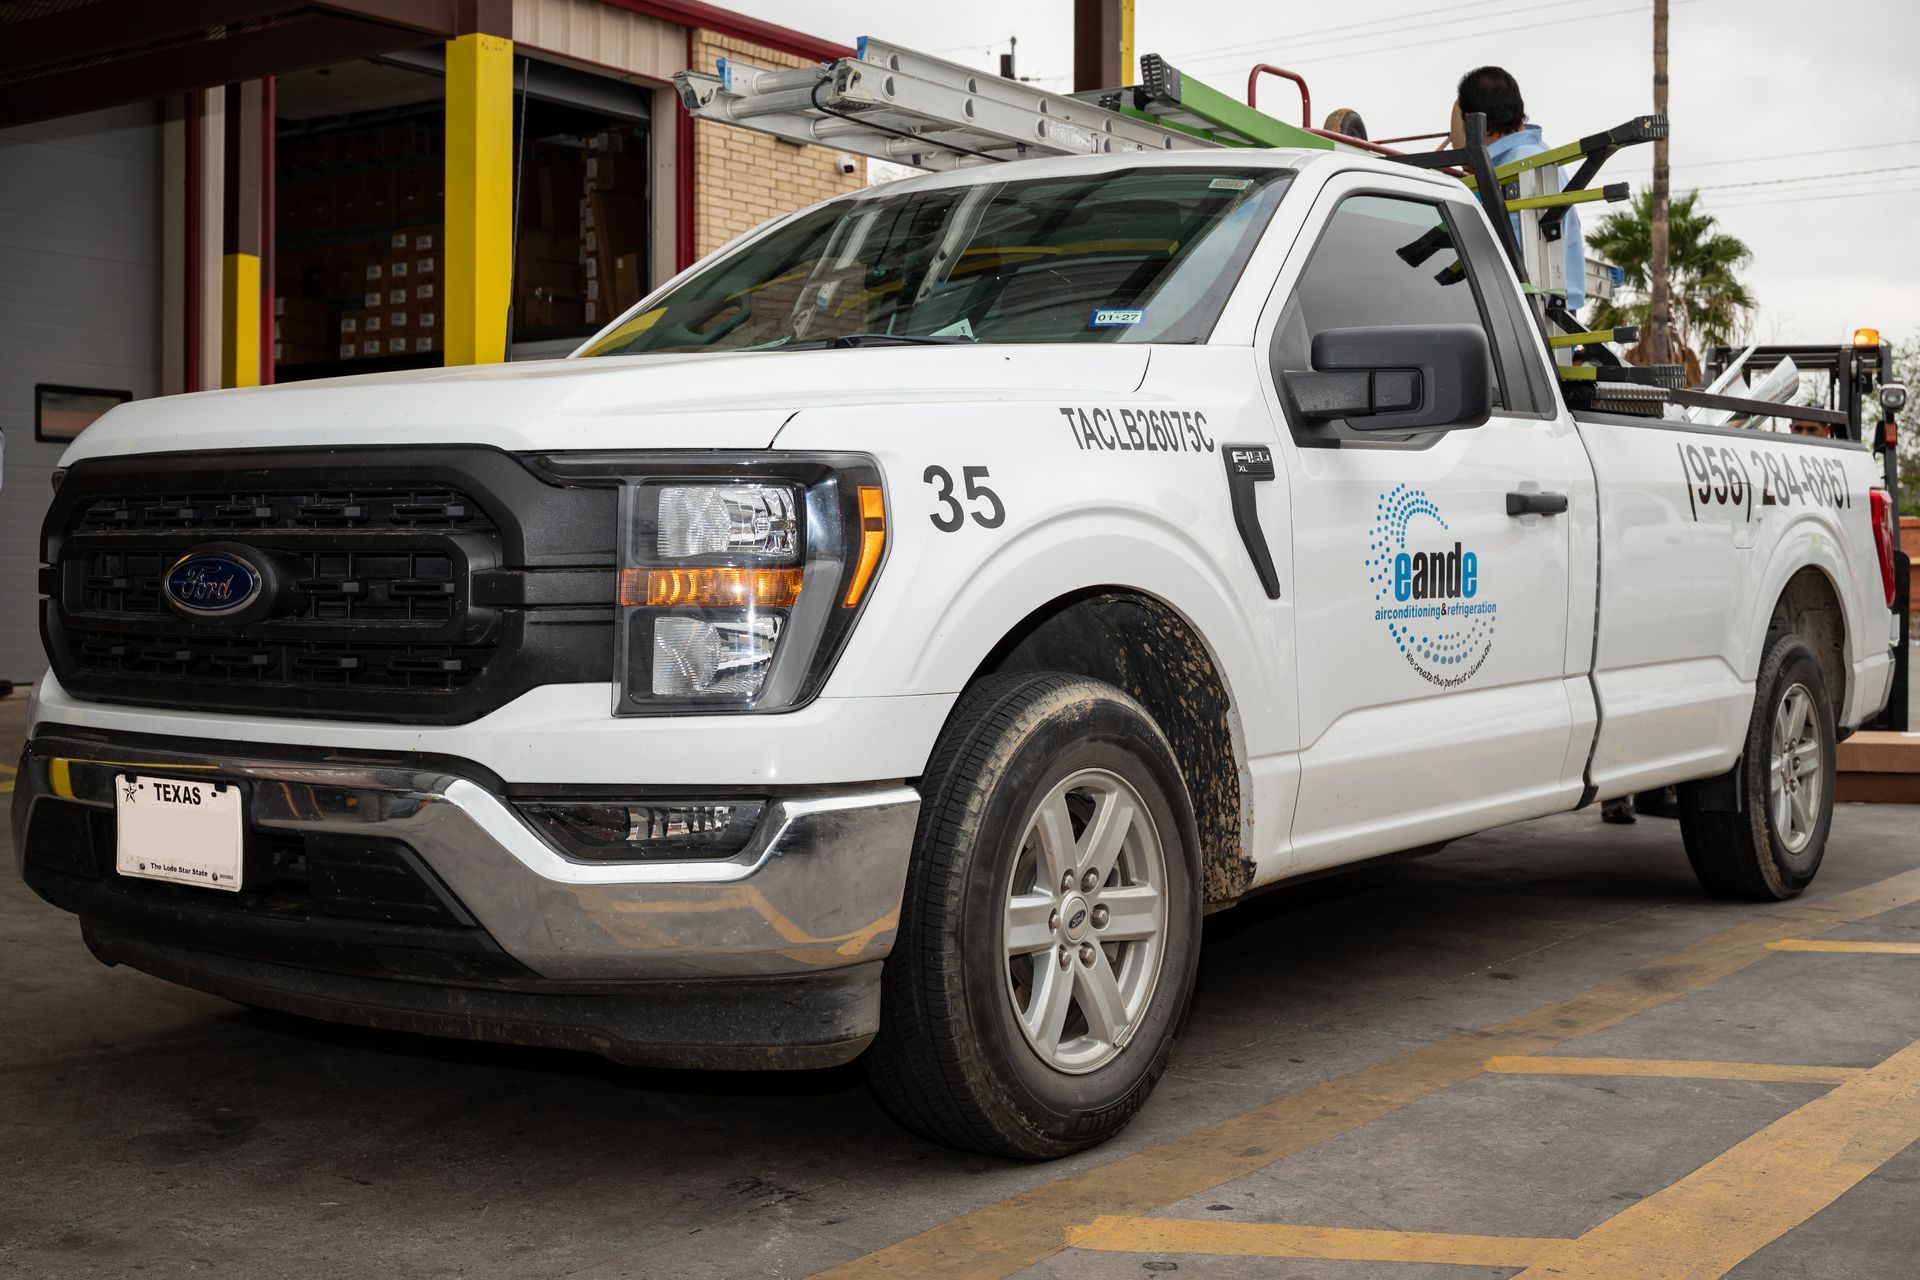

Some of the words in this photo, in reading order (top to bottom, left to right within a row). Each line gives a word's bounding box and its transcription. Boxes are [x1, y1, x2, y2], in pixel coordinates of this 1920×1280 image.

[1059, 407, 1215, 453] TACLB26075C
[1237, 464, 1249, 472] XL
[1677, 442, 1752, 523] (956)
[1750, 450, 1850, 510] 284-6867
[923, 464, 1006, 533] 35
[173, 565, 234, 600] Ford
[1394, 541, 1478, 602] eande
[1405, 649, 1416, 666] We
[1413, 663, 1433, 682] create
[1433, 674, 1445, 687] the
[1443, 672, 1468, 691] perfect
[153, 782, 202, 806] TEXAS
[150, 862, 162, 871] The
[178, 866, 192, 874] Star
[192, 868, 208, 877] State
